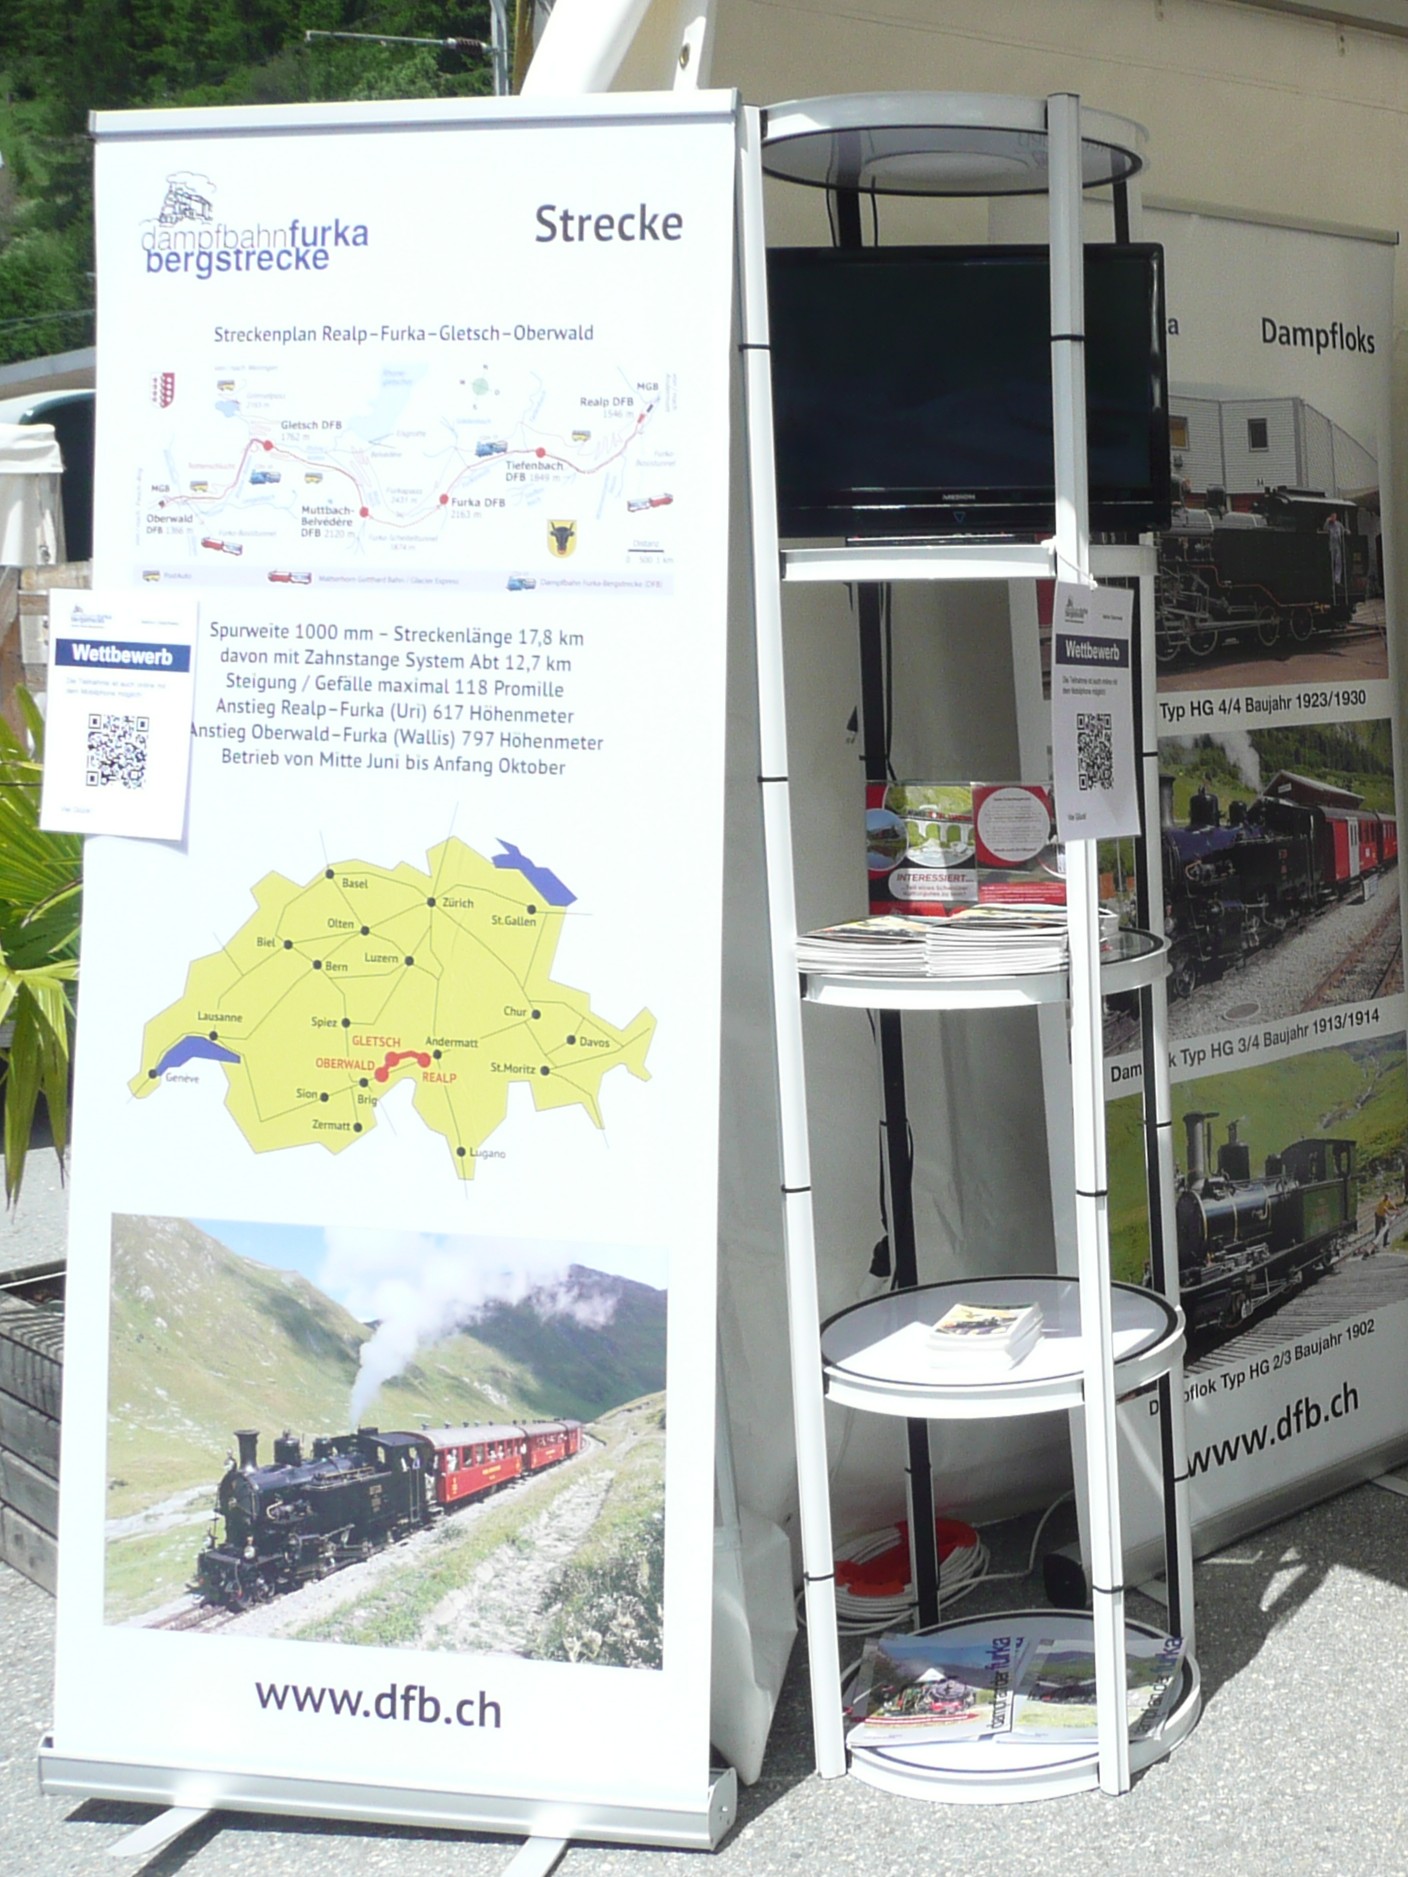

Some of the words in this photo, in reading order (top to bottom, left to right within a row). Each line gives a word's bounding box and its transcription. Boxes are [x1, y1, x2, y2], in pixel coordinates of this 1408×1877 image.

[535, 203, 683, 242] Strecke
[141, 218, 369, 254] dampfbahnfurka
[147, 247, 330, 280] bergstrecke
[214, 325, 317, 345] Streckenplan
[1261, 317, 1375, 355] Dampfloks
[580, 397, 609, 407] Realp
[613, 397, 634, 406] DFB
[281, 421, 318, 430] Gletsch
[321, 421, 342, 429] DFB
[506, 461, 563, 471] Tiefenbach
[451, 499, 481, 507] Furka
[484, 499, 506, 507] DFB
[301, 506, 354, 515] Muttbach-
[146, 514, 193, 524] Oberwald
[210, 622, 289, 640] Spurweite
[296, 624, 338, 641] 1000
[344, 628, 374, 641] mm
[394, 626, 512, 648] Streckenlänge
[519, 630, 552, 648] 17,8
[560, 630, 584, 646] km
[72, 643, 173, 666] Wettbewerb
[1065, 639, 1120, 661] Wettbewerb
[220, 648, 268, 664] davon
[274, 649, 299, 665] mit
[304, 649, 400, 669] Zahnstange
[405, 652, 464, 671] System
[470, 654, 499, 671] Abt
[506, 655, 540, 673] 12,7
[546, 656, 571, 672] km
[226, 673, 297, 693] Steigung
[315, 675, 372, 693] Gefälle
[378, 678, 449, 695] maximal
[455, 680, 488, 696] 118
[494, 681, 564, 698] Promille
[216, 698, 275, 718] Anstieg
[391, 703, 427, 723] (Uri)
[433, 705, 463, 720] 617
[470, 704, 574, 724] Höhenmeter
[1159, 702, 1186, 722] Typ
[1190, 700, 1214, 717] HG
[1218, 697, 1241, 715] 4/4
[1245, 695, 1292, 714] Baujahr
[1296, 689, 1367, 709] 1923/1930
[190, 722, 246, 743] Anstieg
[394, 728, 456, 749] (Wallis)
[462, 732, 494, 748] 797
[500, 732, 604, 751] Höhenmeter
[222, 748, 279, 766] Betrieb
[284, 753, 313, 767] von
[319, 751, 362, 768] Mitte
[367, 753, 399, 769] Juni
[405, 754, 429, 771] bis
[434, 756, 493, 776] Anfang
[499, 758, 566, 776] Oktober
[342, 878, 368, 889] Basel
[442, 896, 474, 908] Zürich
[327, 919, 354, 929] Olten
[257, 937, 276, 947] Biel
[364, 952, 399, 964] Luzern
[325, 961, 348, 972] Bern
[197, 1011, 243, 1023] Lausanne
[504, 1006, 527, 1017] Chur
[311, 1016, 337, 1029] Spiez
[352, 1035, 401, 1048] GLETSCH
[425, 1036, 478, 1048] Andermatt
[580, 1036, 610, 1048] Davos
[1180, 1047, 1206, 1067] Typ
[1211, 1040, 1234, 1059] HG
[1238, 1035, 1260, 1054] 3/4
[1263, 1023, 1309, 1048] Baujahr
[1312, 1007, 1380, 1035] 1913/1914
[316, 1058, 375, 1071] OBERWALD
[422, 1072, 457, 1083] REALP
[296, 1088, 318, 1099] Sion
[357, 1094, 378, 1107] Brig
[312, 1120, 350, 1131] Zermatt
[470, 1148, 506, 1159] Lugano
[1220, 1371, 1246, 1391] Typ
[1249, 1360, 1270, 1379] HG
[1273, 1350, 1292, 1372] 2/3
[1294, 1334, 1343, 1362] Baujahr
[1345, 1319, 1375, 1341] 1902
[1187, 1382, 1359, 1478] www.dfb.ch
[984, 1636, 1011, 1671] furka
[255, 1679, 503, 1729] www.dfb.ch
